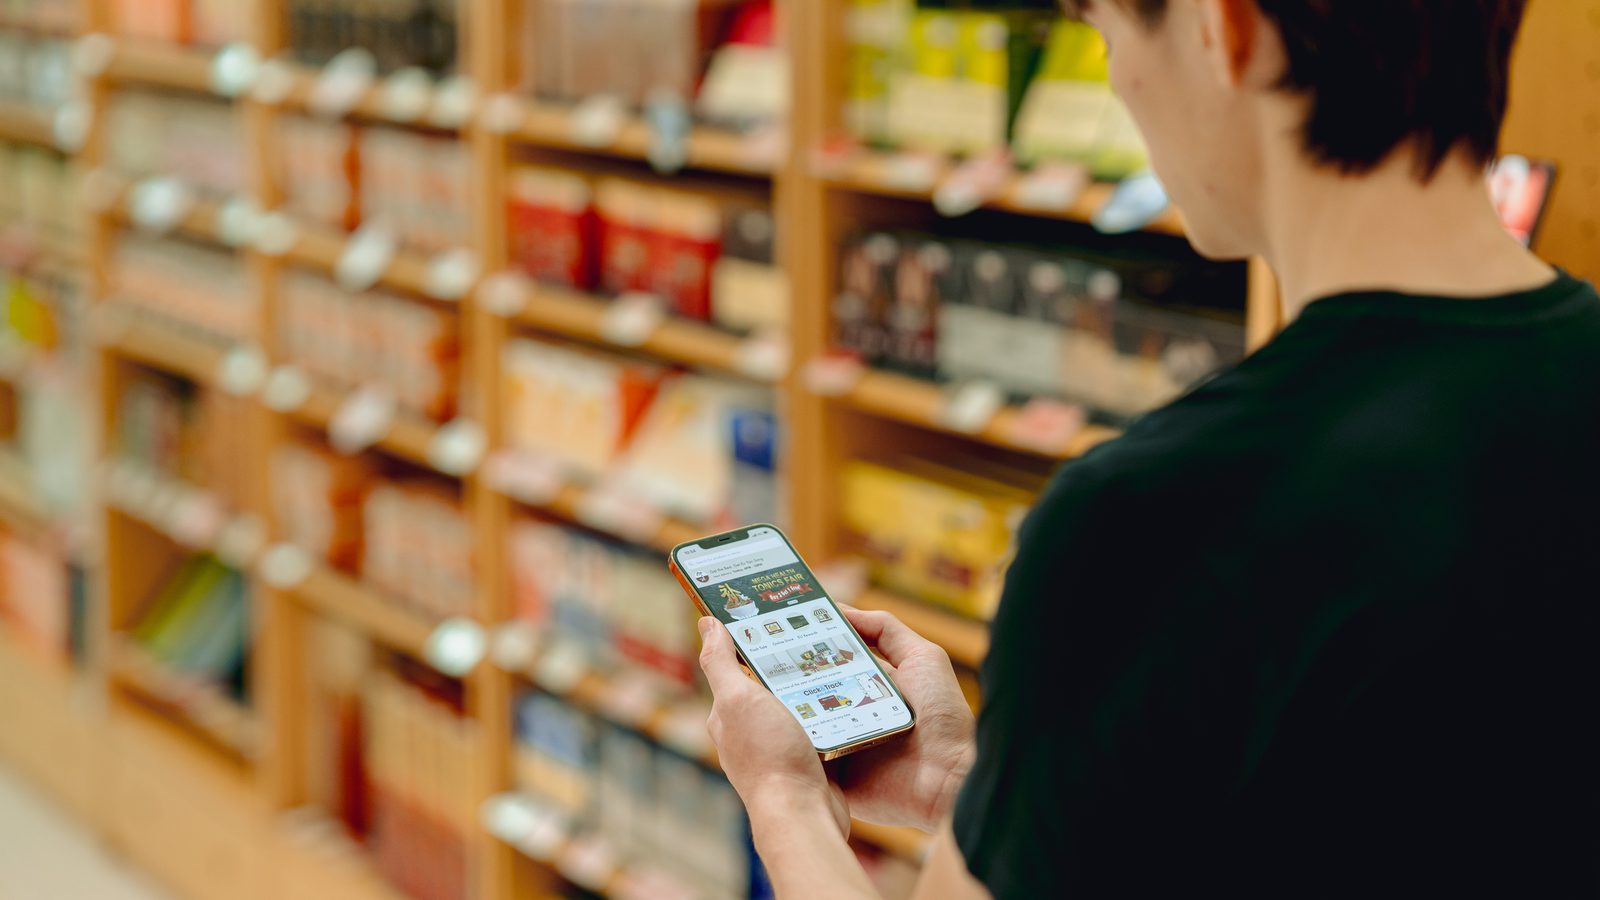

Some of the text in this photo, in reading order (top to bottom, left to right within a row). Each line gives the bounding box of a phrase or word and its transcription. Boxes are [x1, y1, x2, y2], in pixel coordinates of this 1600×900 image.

[751, 569, 796, 584] MEGA HEALTH
[752, 574, 804, 592] TONICS FAIR
[804, 687, 822, 696] Click
[825, 681, 843, 689] Track
